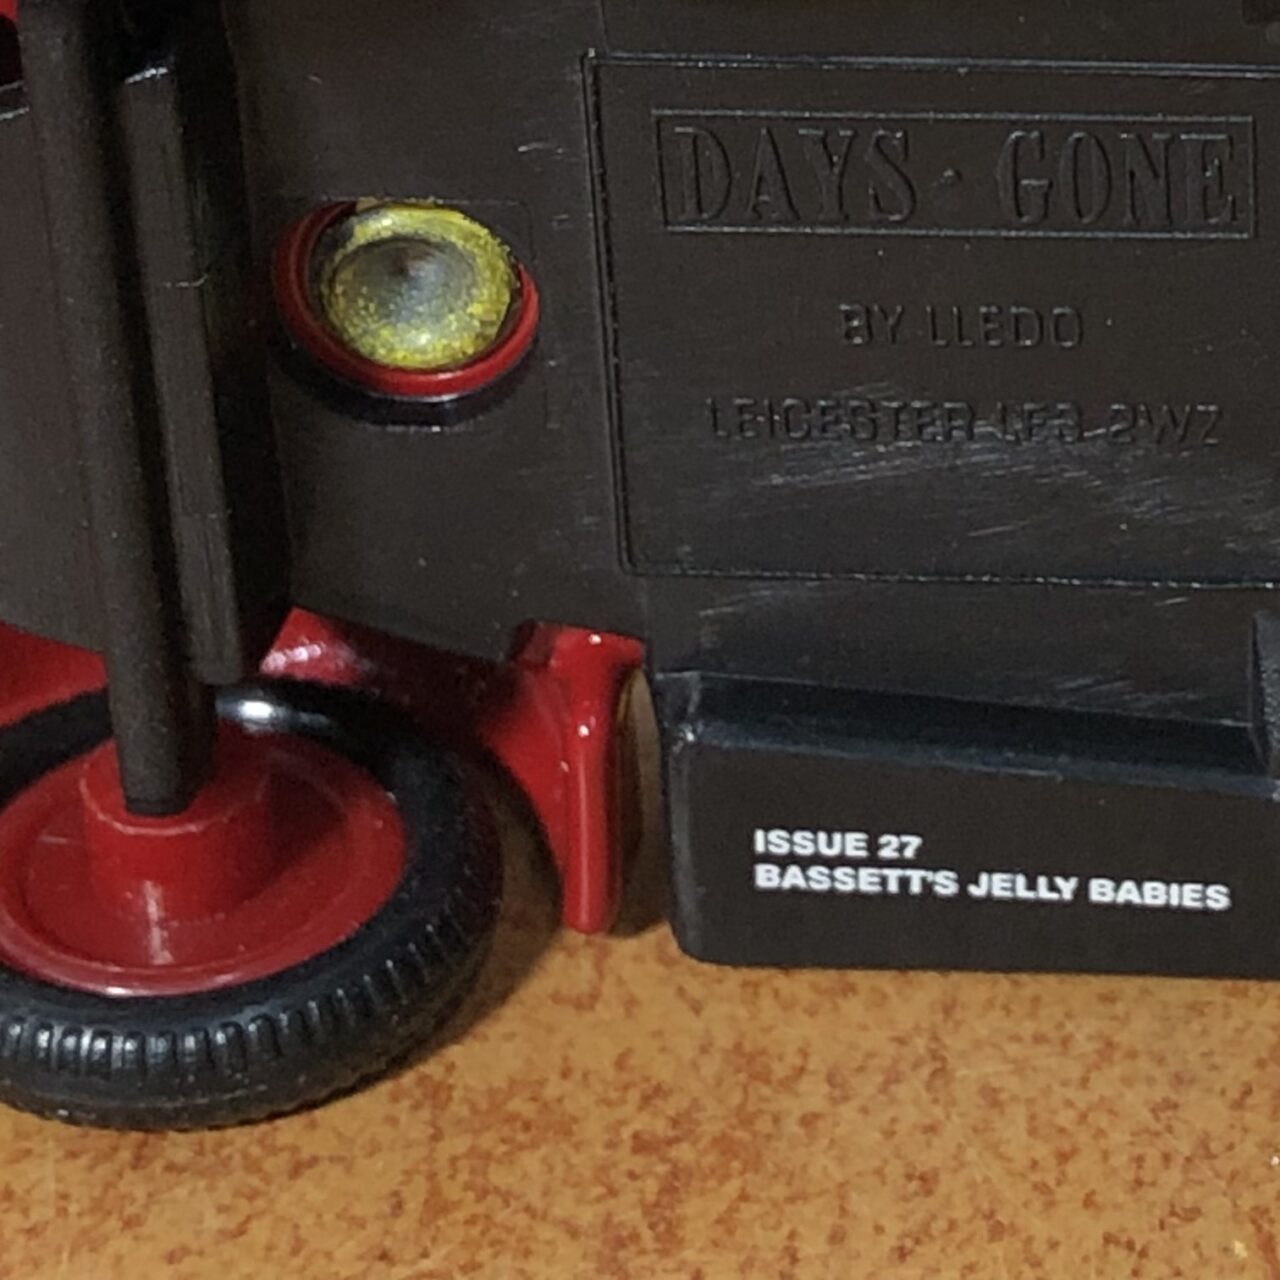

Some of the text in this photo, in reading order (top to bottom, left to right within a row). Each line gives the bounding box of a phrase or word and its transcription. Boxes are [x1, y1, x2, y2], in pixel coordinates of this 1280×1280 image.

[672, 127, 1239, 227] DAYS GONE
[838, 302, 1084, 349] BY LLEDO
[704, 396, 977, 446] LEICESTER
[753, 829, 924, 860] ISSUE 27
[753, 864, 1232, 912] BASSETT'S JELLY BABIES
